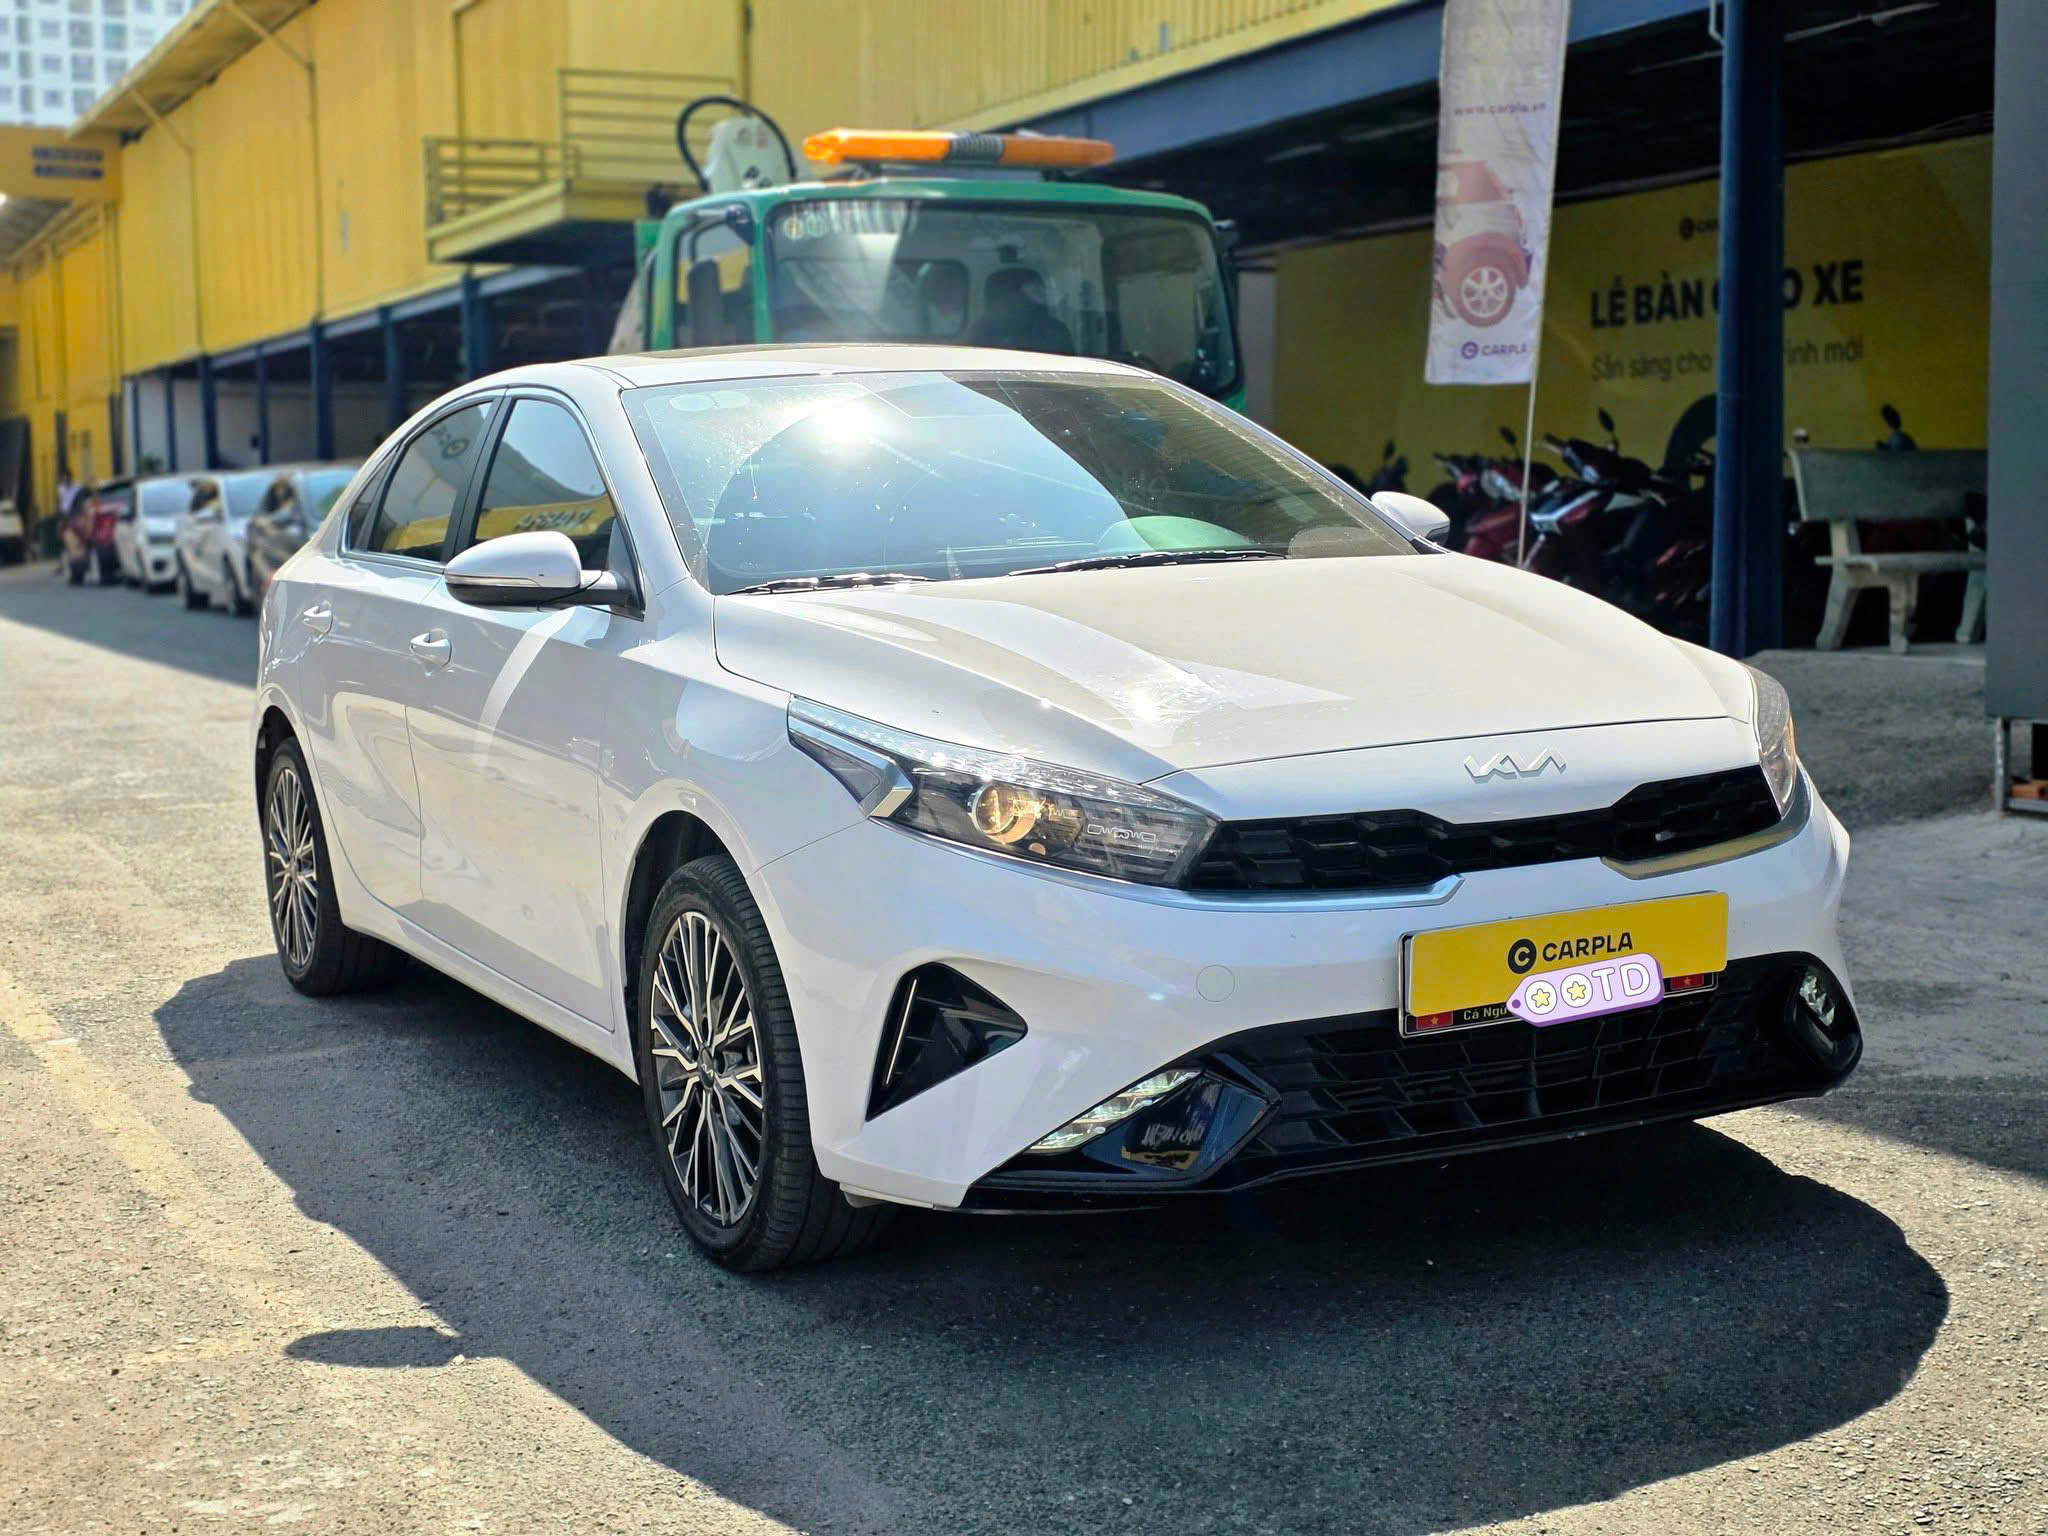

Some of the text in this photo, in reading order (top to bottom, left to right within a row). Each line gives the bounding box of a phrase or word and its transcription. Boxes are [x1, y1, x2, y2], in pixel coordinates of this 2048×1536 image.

[1634, 271, 1704, 324] BÀN
[1813, 260, 1863, 307] XE
[1482, 343, 1528, 356] CARPLA
[1677, 352, 1712, 375] cho
[1542, 932, 1633, 963] CARPLA
